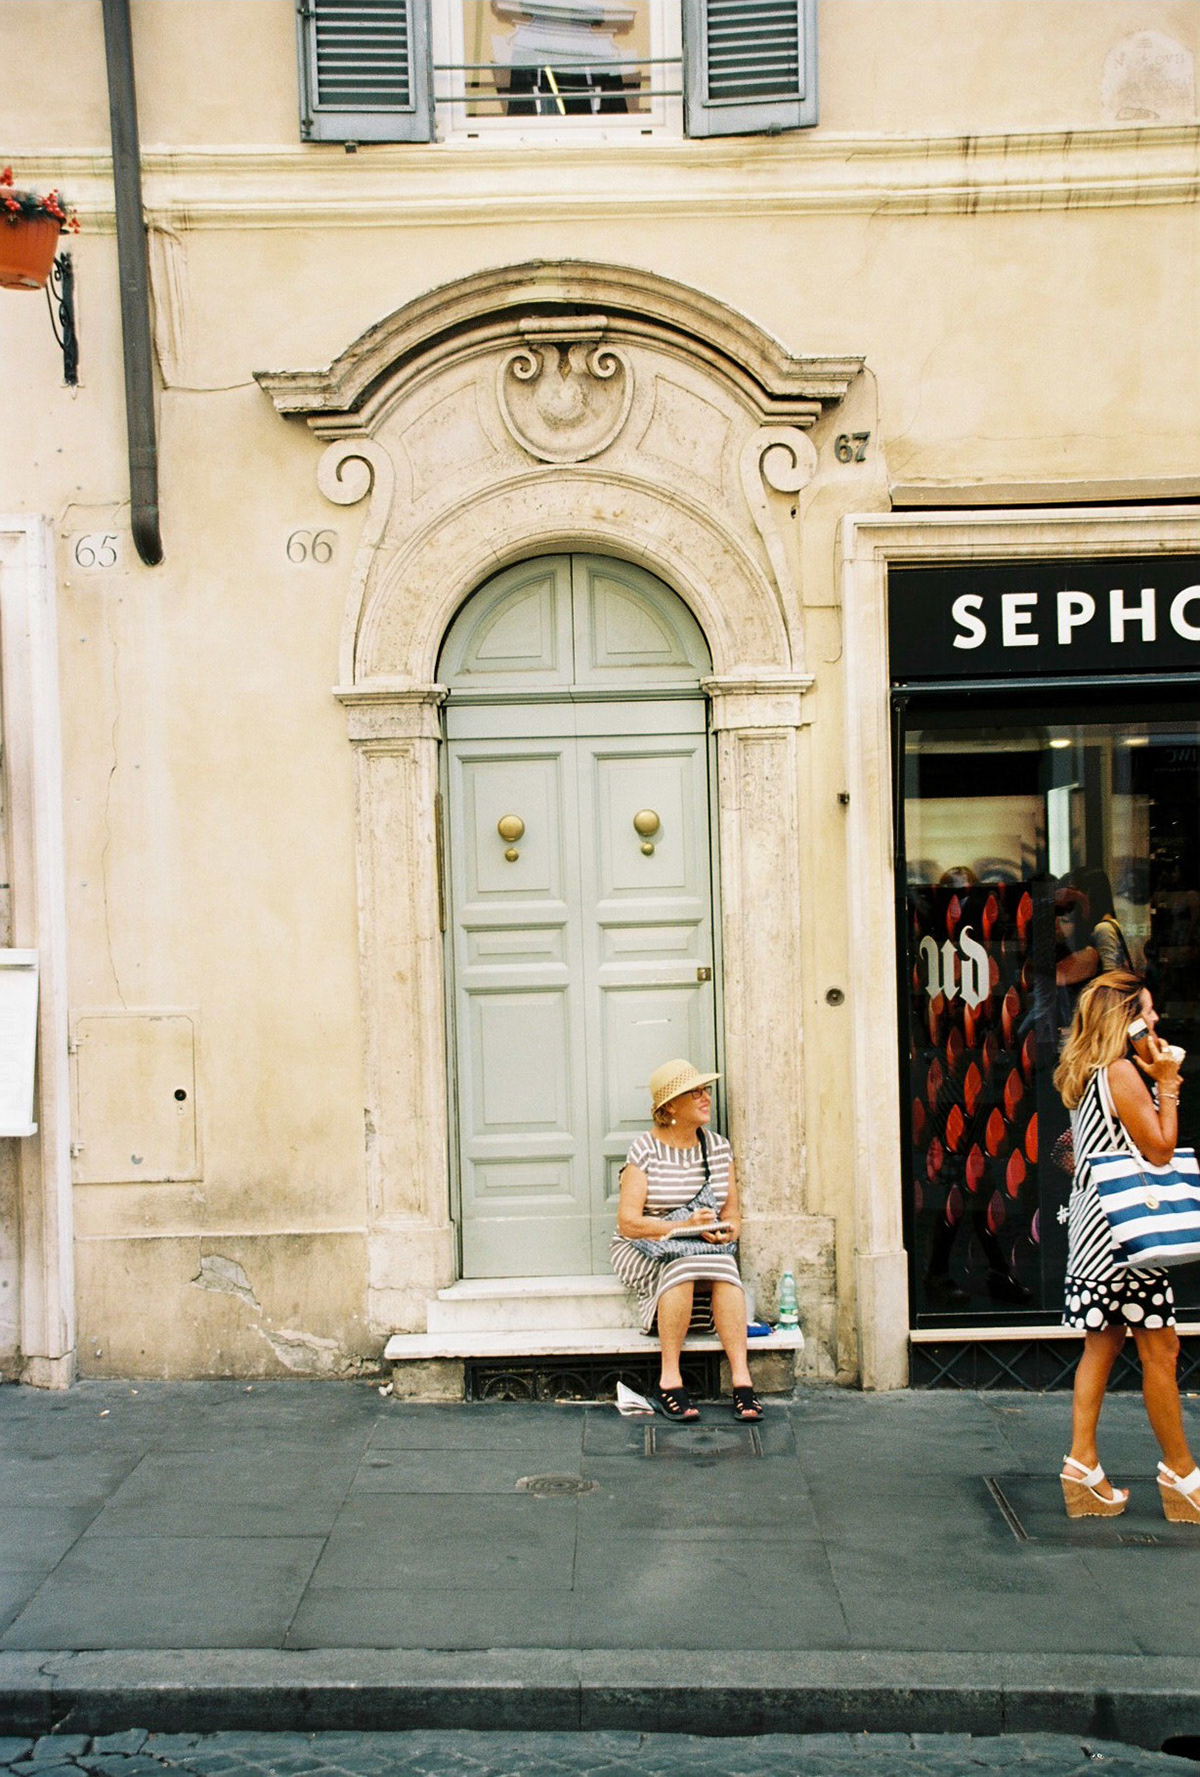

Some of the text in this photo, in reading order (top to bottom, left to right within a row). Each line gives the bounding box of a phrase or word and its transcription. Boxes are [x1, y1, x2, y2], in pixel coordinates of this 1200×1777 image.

[834, 431, 871, 463] 67
[75, 534, 119, 567] 65
[286, 529, 338, 564] 66
